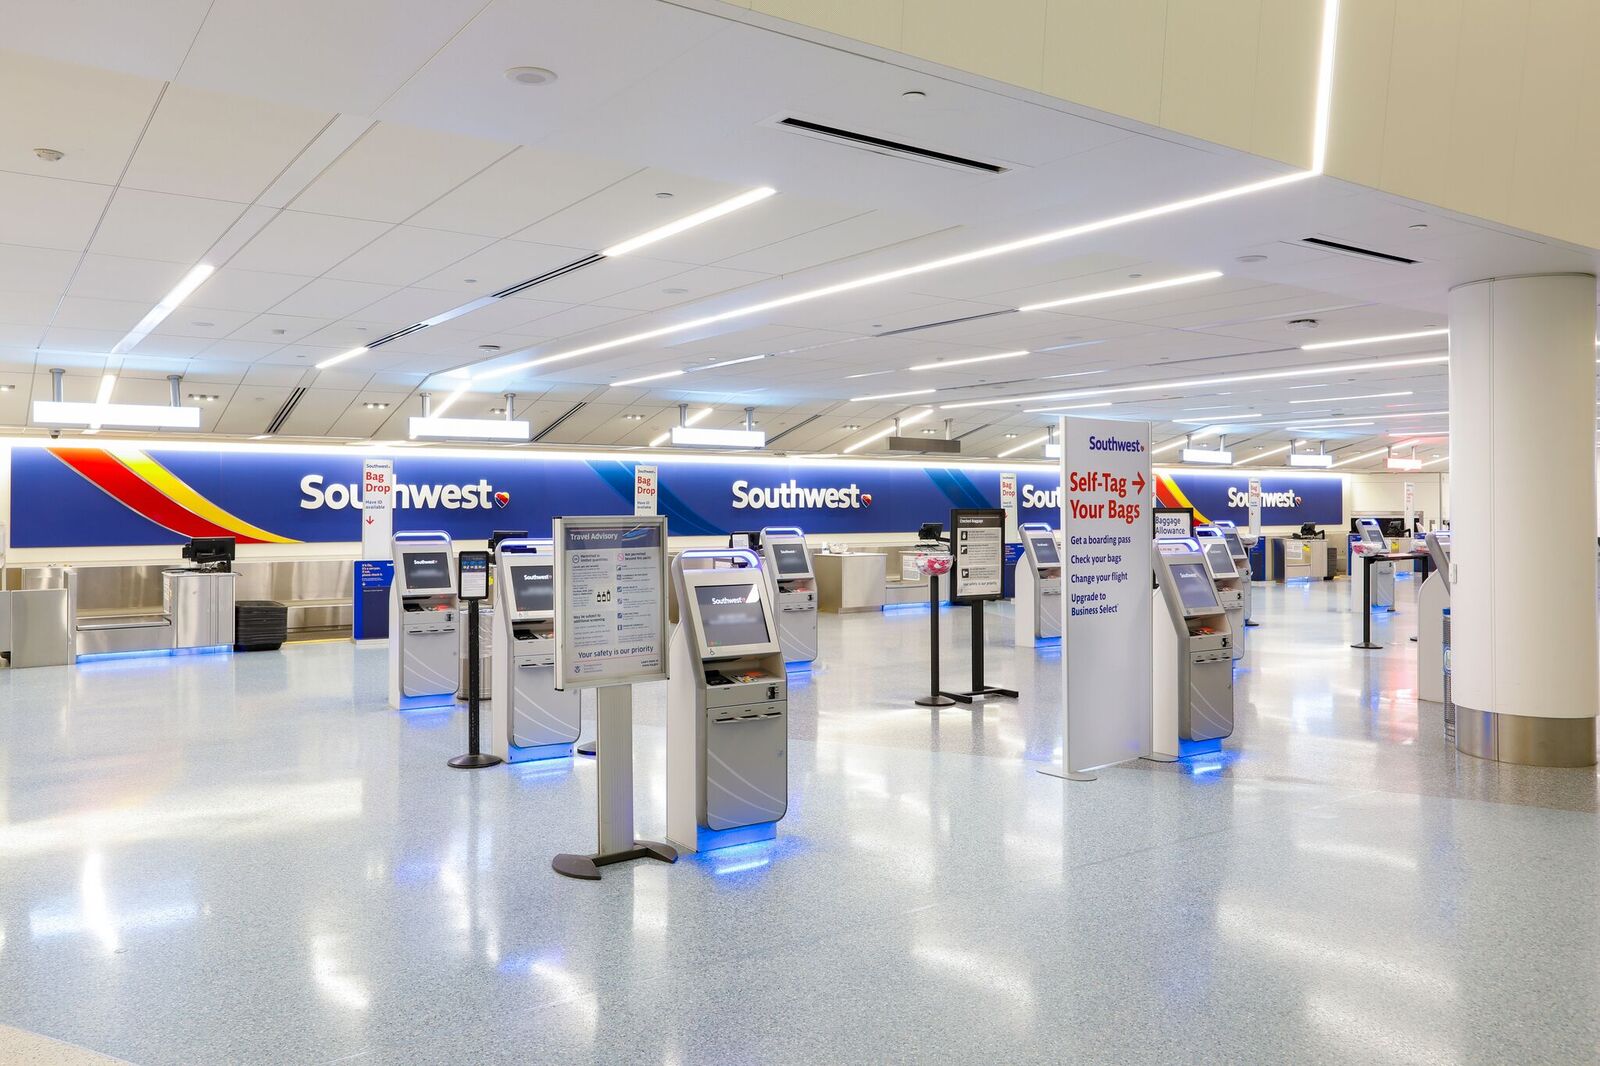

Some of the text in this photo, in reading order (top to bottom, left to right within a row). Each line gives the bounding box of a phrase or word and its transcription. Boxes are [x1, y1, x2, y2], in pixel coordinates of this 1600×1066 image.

[1089, 436, 1140, 453] Southwest
[366, 472, 384, 483] Bag
[637, 476, 651, 486] Bag
[366, 484, 391, 495] Drop
[1070, 471, 1127, 498] Self-Tag
[300, 474, 492, 510] Souhwest
[637, 487, 656, 496] Drop
[732, 480, 860, 509] Southwest
[1070, 499, 1140, 525] Your Bags
[1155, 516, 1181, 526] Baggage
[1155, 527, 1186, 535] Allowance
[570, 533, 618, 542] Travel Advisory
[1071, 536, 1082, 544] Get
[1089, 535, 1117, 546] boarding
[1118, 537, 1131, 546] pass
[1071, 554, 1122, 566] Check your bags
[1071, 572, 1128, 585] Change your flight
[1071, 593, 1107, 604] Upgrade to
[1071, 604, 1118, 617] Business Select
[594, 649, 612, 657] safety
[631, 646, 653, 654] priority
